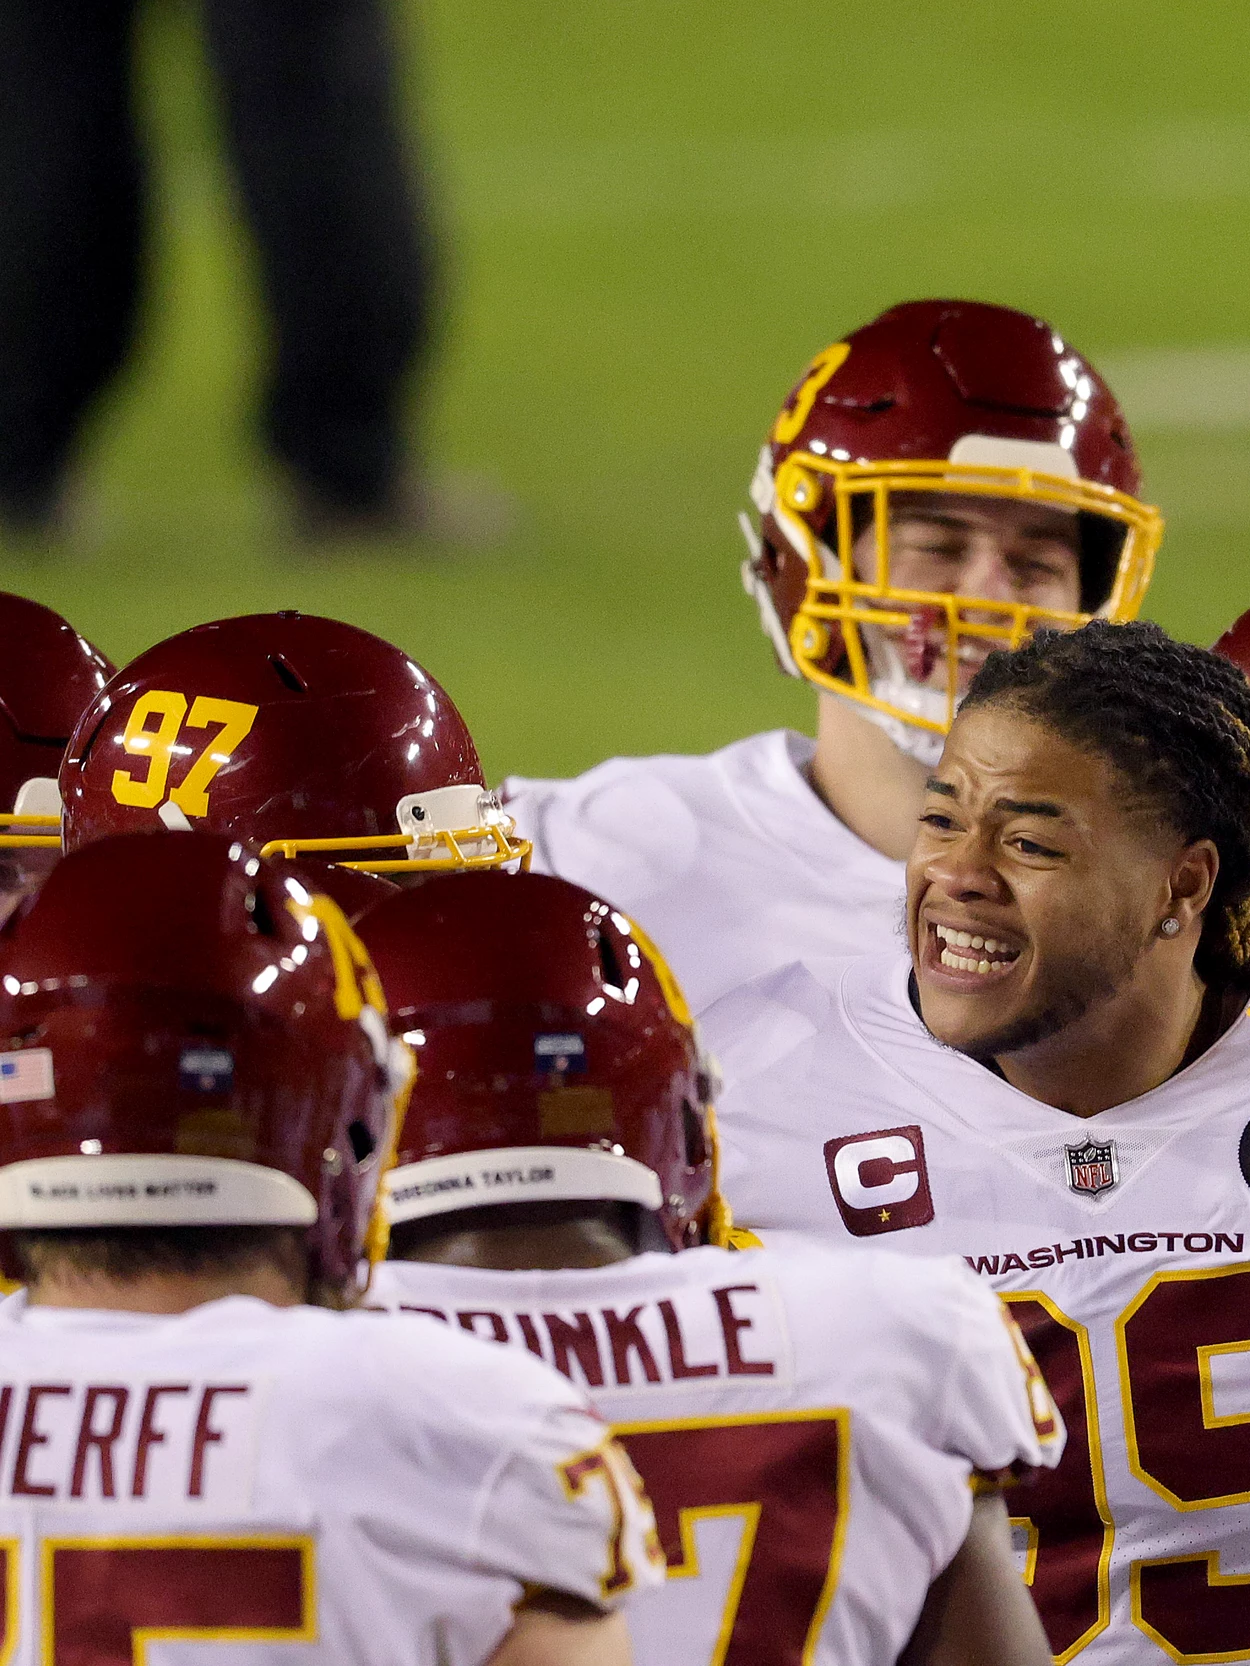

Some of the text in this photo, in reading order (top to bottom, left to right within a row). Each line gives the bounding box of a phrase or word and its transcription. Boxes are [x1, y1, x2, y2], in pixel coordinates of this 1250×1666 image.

[111, 690, 258, 817] 97
[481, 1167, 556, 1187] TAYLOR
[834, 1134, 920, 1210] C
[1074, 1163, 1111, 1188] NFL
[963, 1232, 1244, 1275] WASHINGTON
[362, 1284, 774, 1387] INKLE
[0, 1384, 248, 1498] ERFF
[554, 1446, 664, 1600] 7
